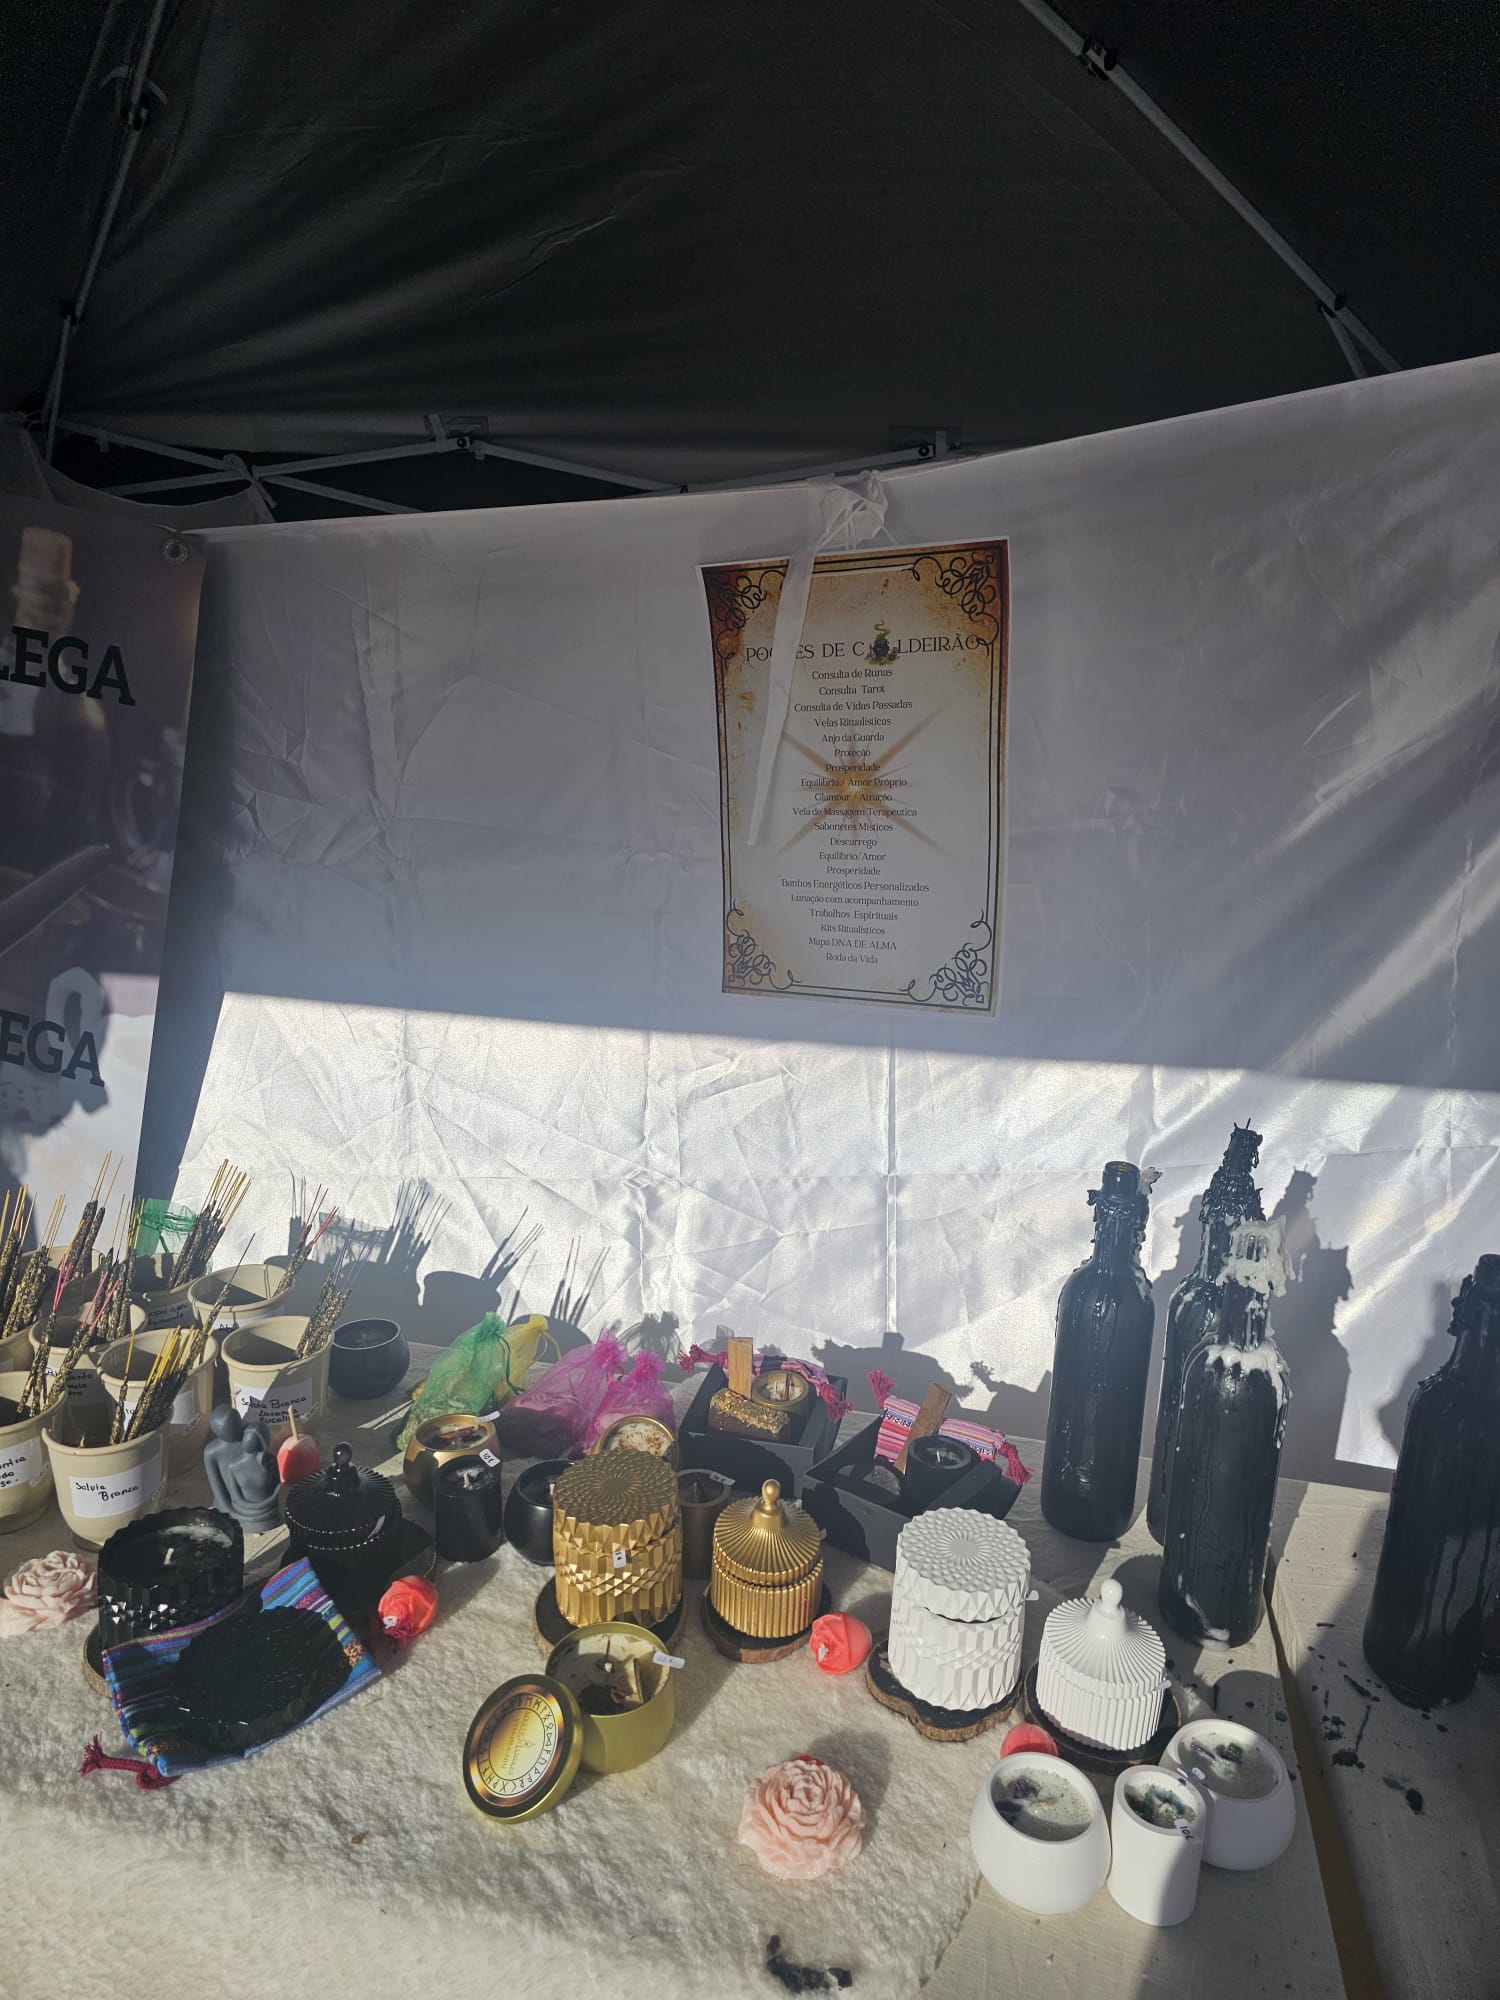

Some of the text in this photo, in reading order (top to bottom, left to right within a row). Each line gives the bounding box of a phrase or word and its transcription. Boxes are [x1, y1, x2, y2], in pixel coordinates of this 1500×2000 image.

[822, 643, 845, 658] DE
[811, 668, 893, 680] Consulta de Runas
[818, 684, 885, 695] Consulta Tarot
[794, 699, 913, 712] Consulta de Vidas Passadas
[814, 716, 838, 727] Velas
[821, 732, 885, 744] Anjo da Guarda
[834, 749, 871, 758] Proteção
[825, 763, 881, 774] Prosperidade
[848, 778, 873, 787] Amor
[874, 777, 908, 789] Próprio
[814, 793, 850, 802] Glamour
[792, 807, 811, 816] Vela
[811, 807, 822, 816] de
[823, 807, 865, 819] Massagem
[814, 821, 857, 831] Sabonetes
[830, 837, 877, 849] Descarrego
[826, 866, 881, 877] Prosperidade
[782, 878, 929, 892] Banhos Energéticos Personalizados
[791, 894, 919, 907] Lunação com acompanhamento
[809, 908, 898, 921] Trabalhos Espirituais
[820, 923, 836, 932] Kits
[808, 937, 897, 950] Mapa DNA DE ALMA
[826, 952, 878, 964] Roda da Vida
